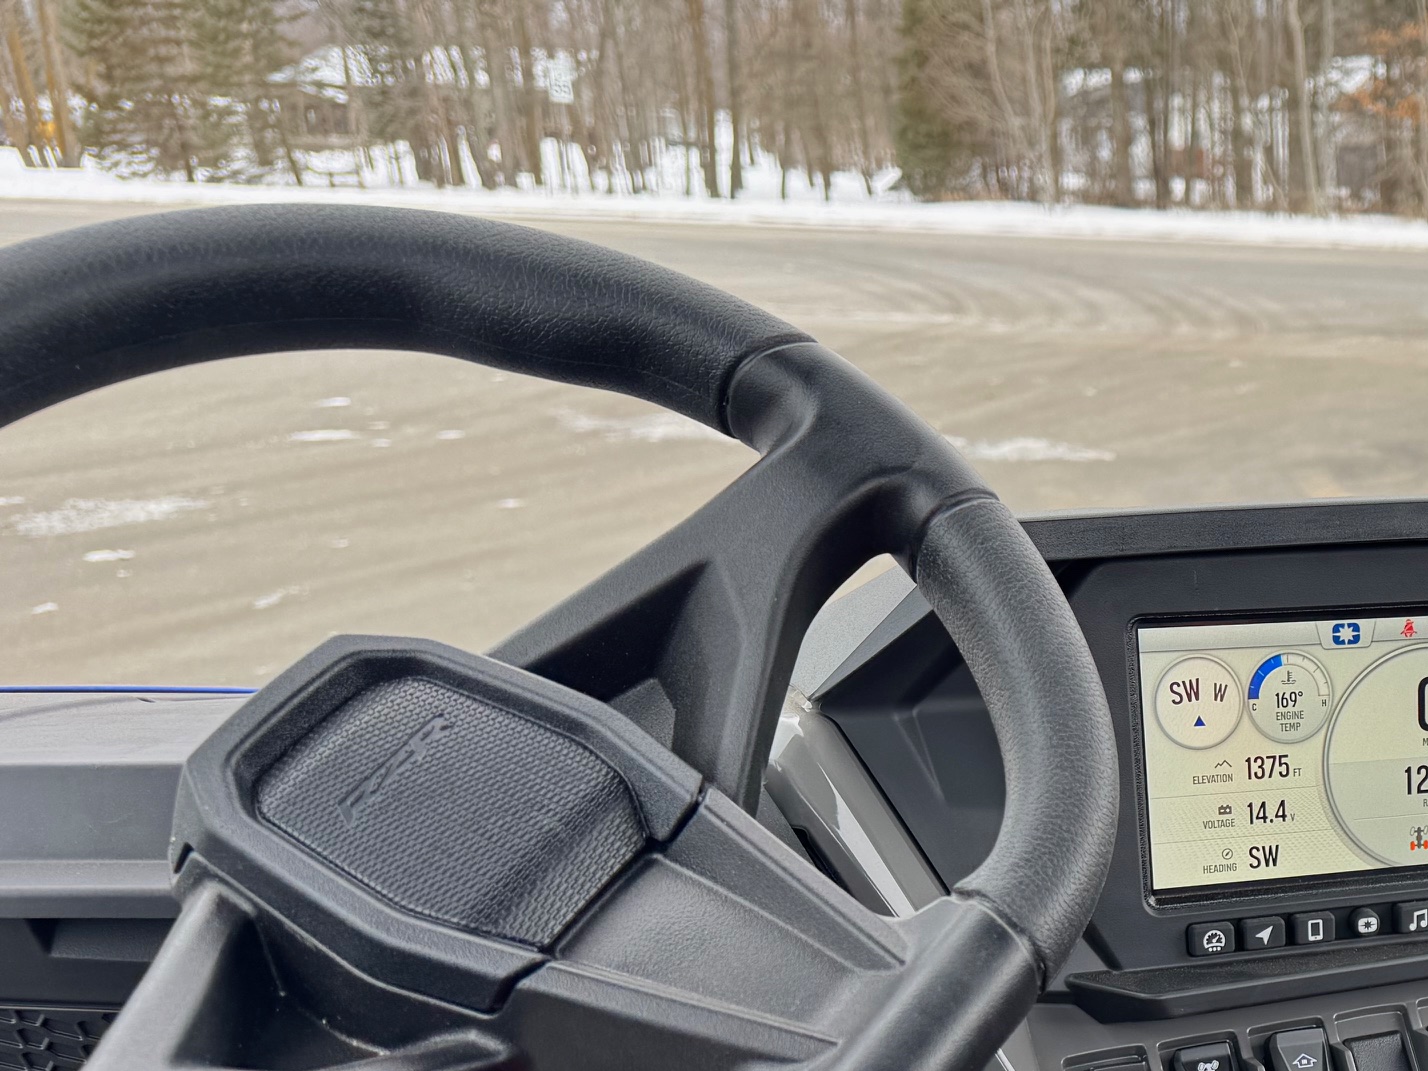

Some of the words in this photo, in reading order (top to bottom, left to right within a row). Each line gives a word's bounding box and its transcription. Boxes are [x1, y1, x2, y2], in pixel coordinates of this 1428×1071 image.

[1169, 677, 1200, 705] SW
[1213, 682, 1228, 703] W
[1275, 691, 1304, 709] 169°
[1321, 698, 1327, 708] H
[1251, 703, 1257, 712] C
[1275, 710, 1304, 721] ENGINE
[1279, 722, 1301, 732] TEMP
[1245, 754, 1290, 780] 1375
[1293, 768, 1302, 777] FT
[1192, 773, 1234, 785] ELEVATION
[1247, 799, 1287, 825] 14.4
[1202, 818, 1236, 830] VOLTAGE
[1248, 844, 1280, 869] SW
[1202, 862, 1238, 874] HEADING
